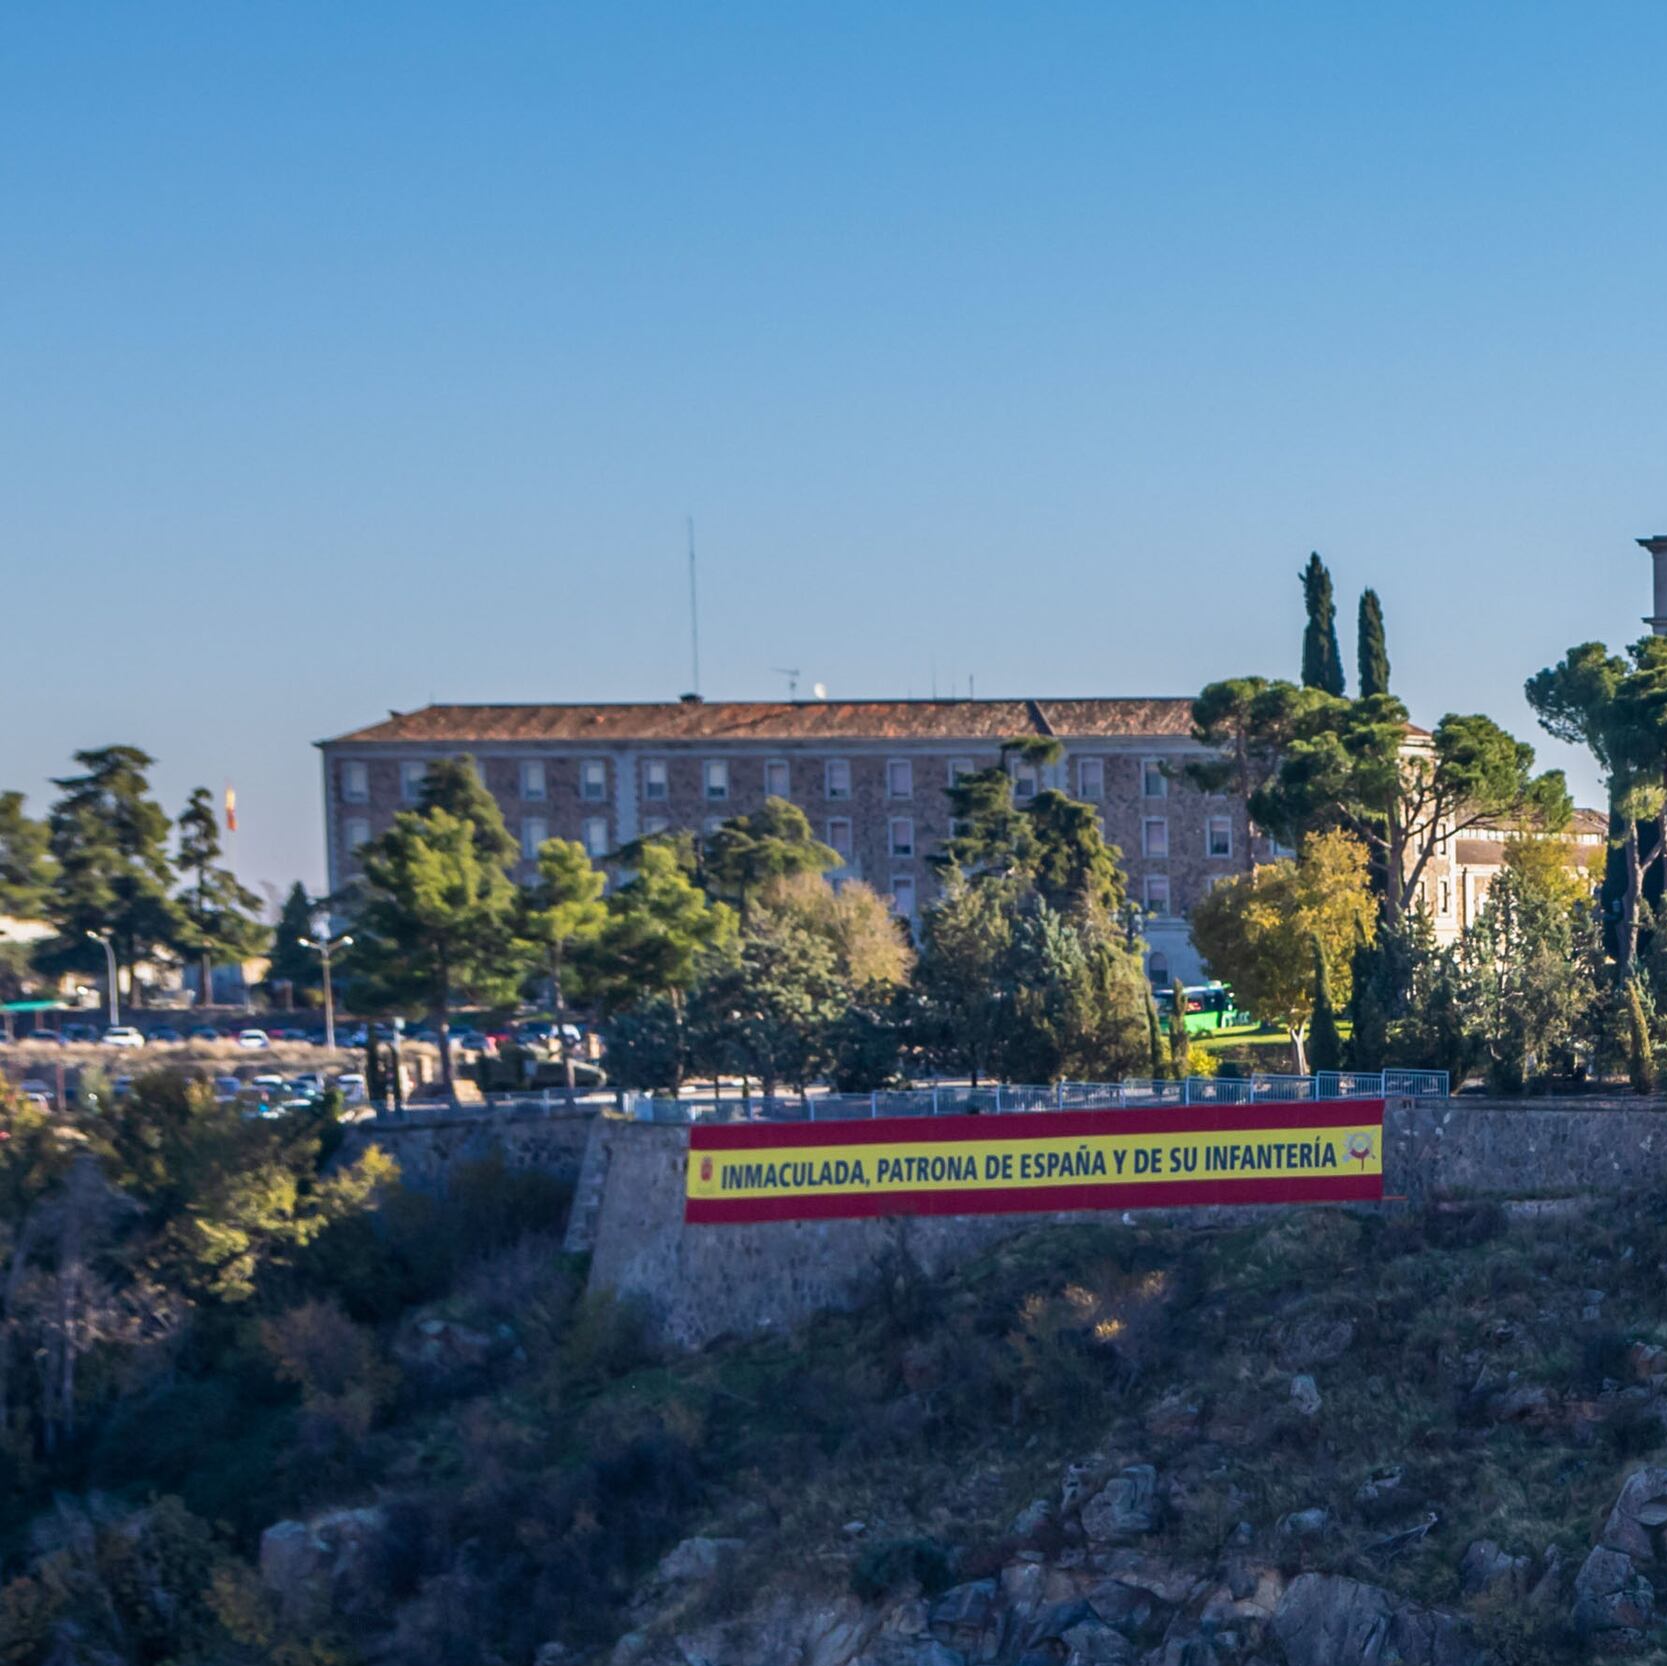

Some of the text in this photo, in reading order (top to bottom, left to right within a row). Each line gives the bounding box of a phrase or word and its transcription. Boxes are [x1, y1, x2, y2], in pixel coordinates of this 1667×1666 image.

[722, 1136, 1337, 1189] INMACULADA, PATRONA DE ESPAÑA Y DE SU INFANTERÍA
